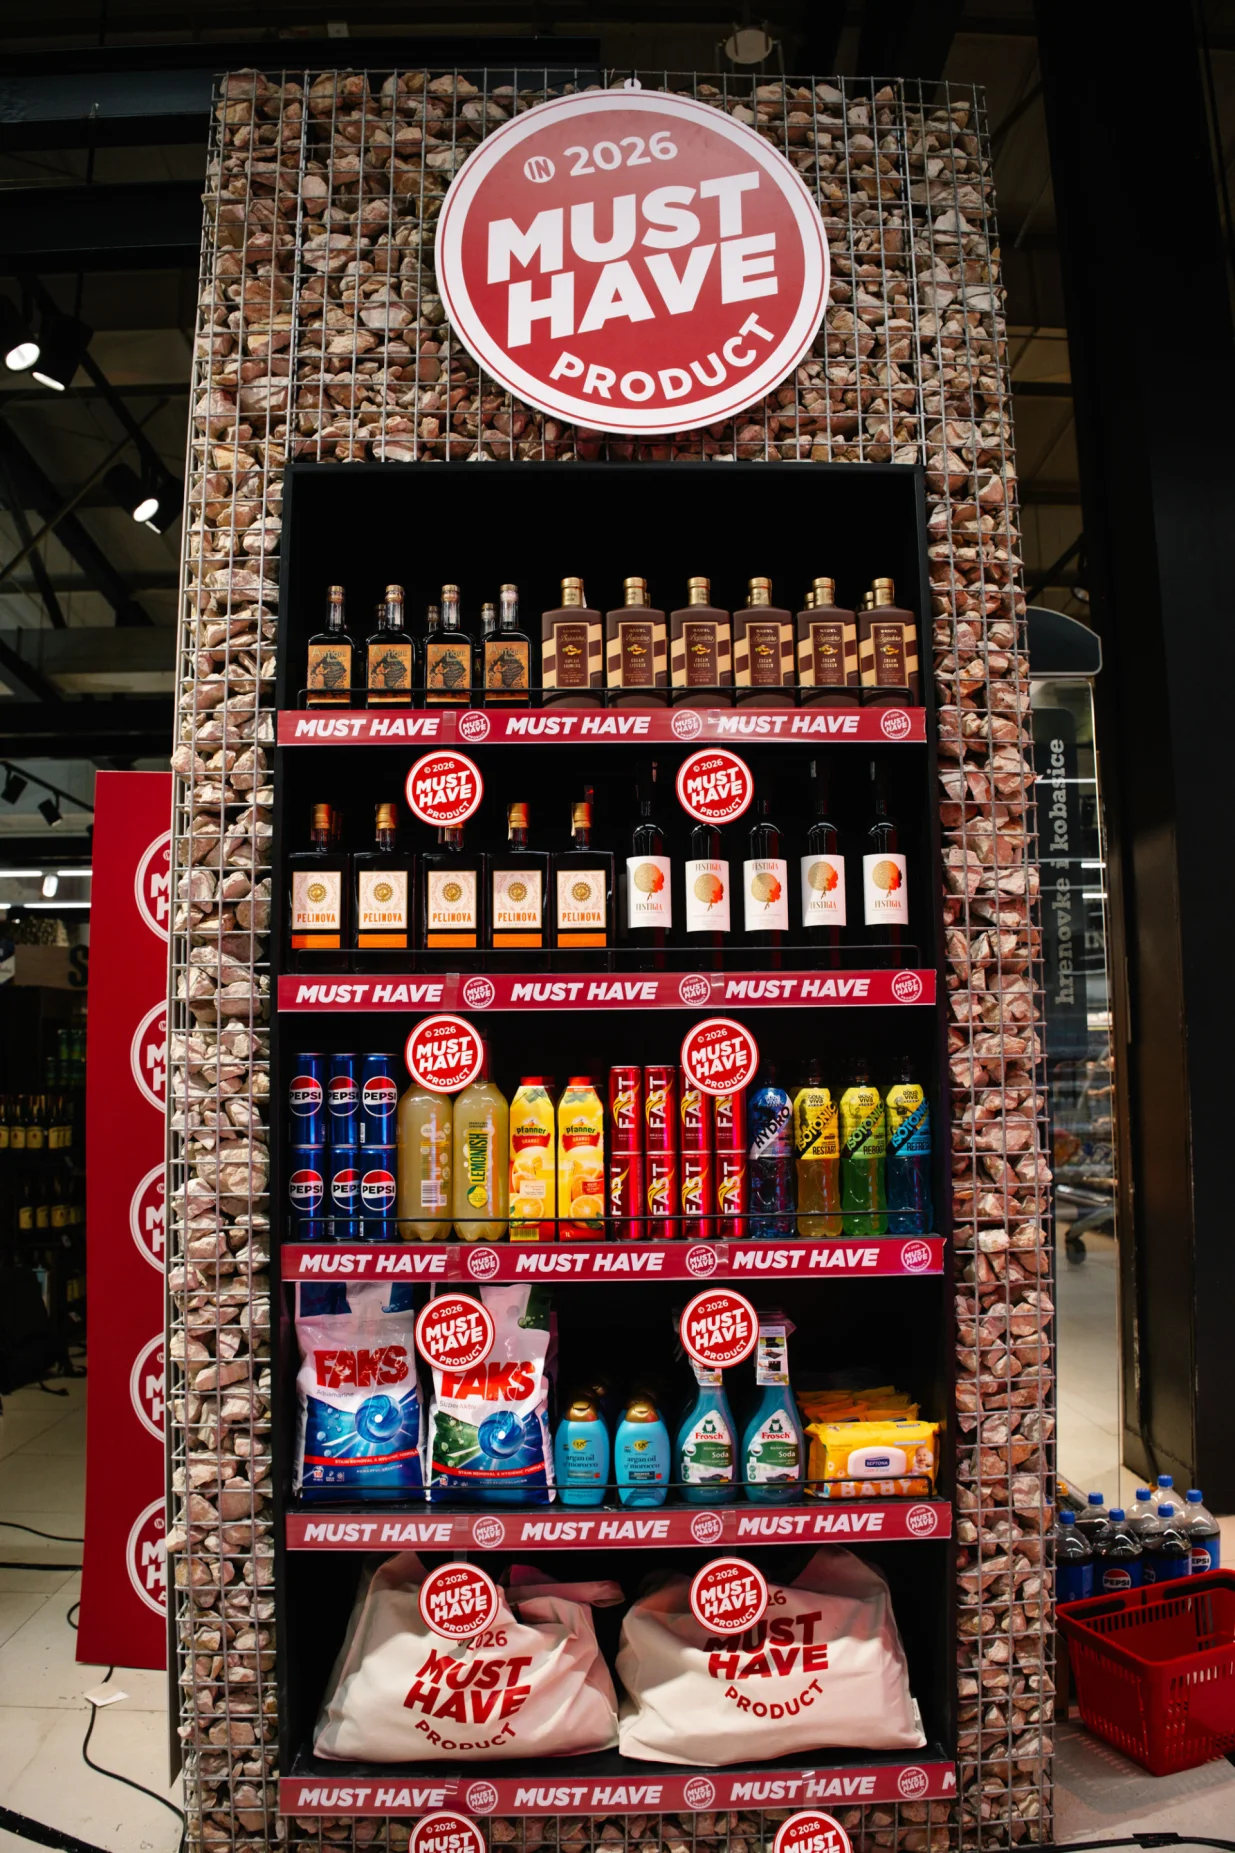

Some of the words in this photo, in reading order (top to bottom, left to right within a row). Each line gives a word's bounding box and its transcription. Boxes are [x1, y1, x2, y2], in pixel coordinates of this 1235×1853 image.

[527, 159, 552, 180] IN
[563, 131, 678, 177] 2026
[487, 170, 760, 285] MUST
[507, 232, 779, 349] HAVE
[549, 312, 775, 402] PRODUCT
[294, 719, 368, 737] MUST
[369, 718, 440, 736] HAVE
[506, 717, 578, 734] MUST
[580, 717, 651, 734] HAVE
[717, 716, 788, 733] MUST
[790, 716, 860, 733] HAVE
[432, 762, 454, 772] 2026
[702, 759, 722, 770] 2026
[416, 770, 471, 796] MUST
[688, 767, 739, 793] MUST
[421, 784, 473, 807] HAVE
[692, 780, 743, 806] HAVE
[1046, 738, 1069, 851] kobasice
[427, 801, 469, 820] PRODUCT
[700, 798, 742, 817] PRODUCT
[297, 913, 336, 923] PELINOVA
[364, 913, 402, 923] PELINOVA
[433, 912, 471, 922] PELINOVA
[498, 912, 536, 922] PELINOVA
[562, 912, 601, 922] PELINOVA
[1051, 877, 1074, 1005] hrenovke
[296, 985, 369, 1003] MUST
[371, 984, 444, 1003] HAVE
[467, 984, 489, 995] MUST
[468, 989, 490, 1001] HAVE
[511, 983, 584, 1001] MUST
[586, 982, 658, 1000] HAVE
[725, 980, 797, 998] MUST
[800, 979, 870, 997] HAVE
[434, 1026, 456, 1037] 2026
[706, 1029, 727, 1040] 2026
[416, 1036, 471, 1061] MUST
[692, 1037, 744, 1065] MUST
[420, 1050, 473, 1073] HAVE
[696, 1050, 747, 1079] HAVE
[426, 1068, 470, 1086] PRODUCT
[705, 1068, 747, 1088] PRODUCT
[290, 1091, 321, 1100] PEPSI
[328, 1091, 359, 1100] PEPSI
[364, 1091, 397, 1100] PEPSI
[618, 1075, 635, 1128] FAST
[650, 1075, 666, 1128] FAST
[516, 1126, 546, 1134] pfanner
[565, 1126, 595, 1134] pfanner
[754, 1106, 791, 1149] HYDRO
[797, 1102, 838, 1151] ISOTONIC
[846, 1102, 886, 1151] ISOTONIC
[891, 1097, 930, 1148] ISOTONIC
[468, 1133, 488, 1182] LEMONISH
[812, 1145, 836, 1155] RESTART
[863, 1145, 885, 1155] REBOOT
[290, 1185, 323, 1194] PEPSI
[362, 1185, 395, 1194] PEPSI
[652, 1163, 670, 1216] FAST
[685, 1162, 703, 1215] FAST
[723, 1161, 741, 1215] FAST
[300, 1254, 373, 1273] MUST
[375, 1254, 448, 1273] HAVE
[516, 1253, 589, 1272] MUST
[592, 1252, 664, 1271] HAVE
[690, 1253, 712, 1264] MUST
[691, 1258, 713, 1270] HAVE
[733, 1250, 806, 1269] MUST
[808, 1249, 880, 1268] HAVE
[440, 1305, 462, 1316] 2026
[706, 1300, 728, 1311] 2026
[426, 1313, 479, 1342] MUST
[692, 1308, 745, 1336] MUST
[431, 1326, 482, 1355] HAVE
[696, 1322, 748, 1350] HAVE
[440, 1345, 482, 1365] PRODUCT
[704, 1340, 747, 1360] PRODUCT
[313, 1345, 409, 1389] FAKS
[440, 1361, 536, 1402] FAKS
[316, 1389, 355, 1398] Aquamarine
[695, 1432, 724, 1440] Frosch
[565, 1455, 585, 1463] argan
[841, 1479, 912, 1497] BABY
[304, 1523, 378, 1542] MUST
[379, 1523, 453, 1542] HAVE
[521, 1522, 594, 1541] MUST
[597, 1520, 670, 1539] HAVE
[738, 1516, 811, 1535] MUST
[813, 1513, 885, 1533] HAVE
[446, 1573, 468, 1584] 2026
[716, 1569, 738, 1580] 2026
[1104, 1578, 1130, 1586] PEPSI
[431, 1581, 484, 1609] MUST
[701, 1576, 755, 1604] MUST
[435, 1595, 487, 1622] HAVE
[705, 1590, 757, 1618] HAVE
[444, 1613, 486, 1633] PRODUCT
[714, 1608, 756, 1627] PRODUCT
[703, 1611, 822, 1654] MUST
[415, 1649, 533, 1689] MUST
[708, 1643, 829, 1680] HAVE
[403, 1680, 531, 1724] HAVE
[724, 1678, 824, 1720] PRODUCT
[415, 1720, 517, 1750] PRODUCT
[298, 1788, 371, 1807] MUST
[374, 1788, 446, 1807] HAVE
[514, 1787, 588, 1807] MUST
[591, 1786, 662, 1805] HAVE
[730, 1780, 803, 1800] MUST
[804, 1777, 877, 1797] HAVE
[435, 1822, 457, 1832] 2026
[798, 1822, 820, 1834] 2026
[419, 1832, 473, 1853] MUST
[784, 1830, 837, 1853] MUST
